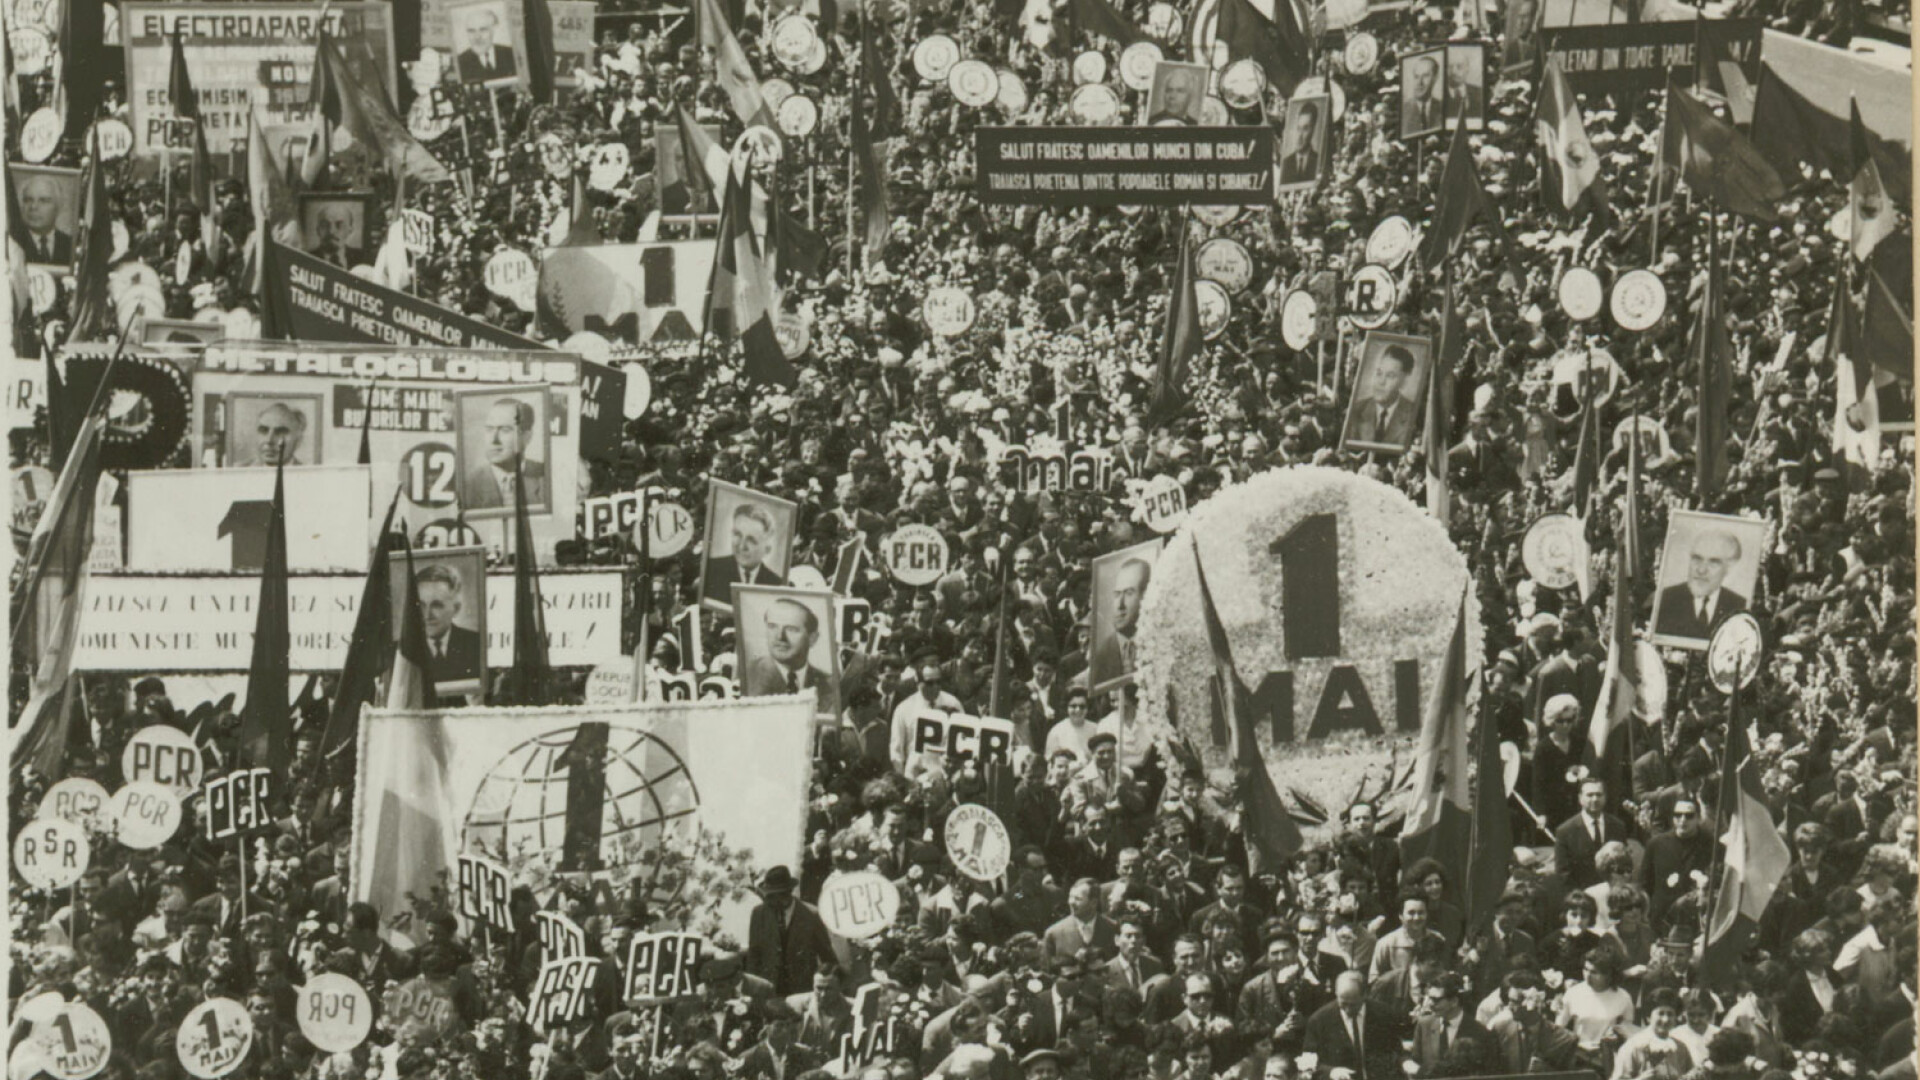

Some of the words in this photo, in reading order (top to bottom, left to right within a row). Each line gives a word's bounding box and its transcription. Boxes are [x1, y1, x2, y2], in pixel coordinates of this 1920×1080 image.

[1602, 47, 1620, 71] DIN
[1625, 45, 1655, 69] TOATE
[147, 89, 247, 106] ECMISIM
[1000, 142, 1034, 160] SALUT
[1088, 142, 1149, 160] OAMENILOR
[1153, 142, 1190, 160] MUNCII
[1194, 142, 1213, 160] DIN
[1215, 139, 1256, 160] CUBA!
[1033, 172, 1080, 190] PRIETENIA
[1083, 172, 1116, 190] DINTRE
[1118, 172, 1171, 190] POPOARELE
[1219, 170, 1268, 190] CUBANEZ!
[639, 247, 676, 308] 1
[289, 286, 345, 323] TRAIASCA
[290, 264, 326, 293] SALUT
[333, 282, 384, 316] FRATESC
[393, 306, 463, 346] OAMENILOR
[203, 346, 577, 383] METALOGLOBUS
[410, 451, 456, 501] 12
[1004, 450, 1113, 491] mai
[1145, 487, 1184, 522] PCR
[892, 542, 943, 570] PCR
[190, 595, 317, 612] UNITEA
[1269, 513, 1341, 661] 1
[80, 632, 197, 650] OMUNISTE
[1210, 658, 1423, 748] MAI
[915, 717, 1010, 765] PCR
[133, 741, 196, 789] PCR
[123, 792, 170, 828] PCR
[206, 769, 271, 840] PCR
[553, 721, 610, 874] 1
[24, 828, 77, 868] RSR
[971, 821, 988, 858] 1
[459, 857, 515, 934] PCR
[830, 881, 885, 930] PCR
[628, 934, 703, 999] PCR
[197, 1009, 222, 1050] 1
[394, 988, 450, 1031] PCR
[52, 1013, 77, 1054] 1
